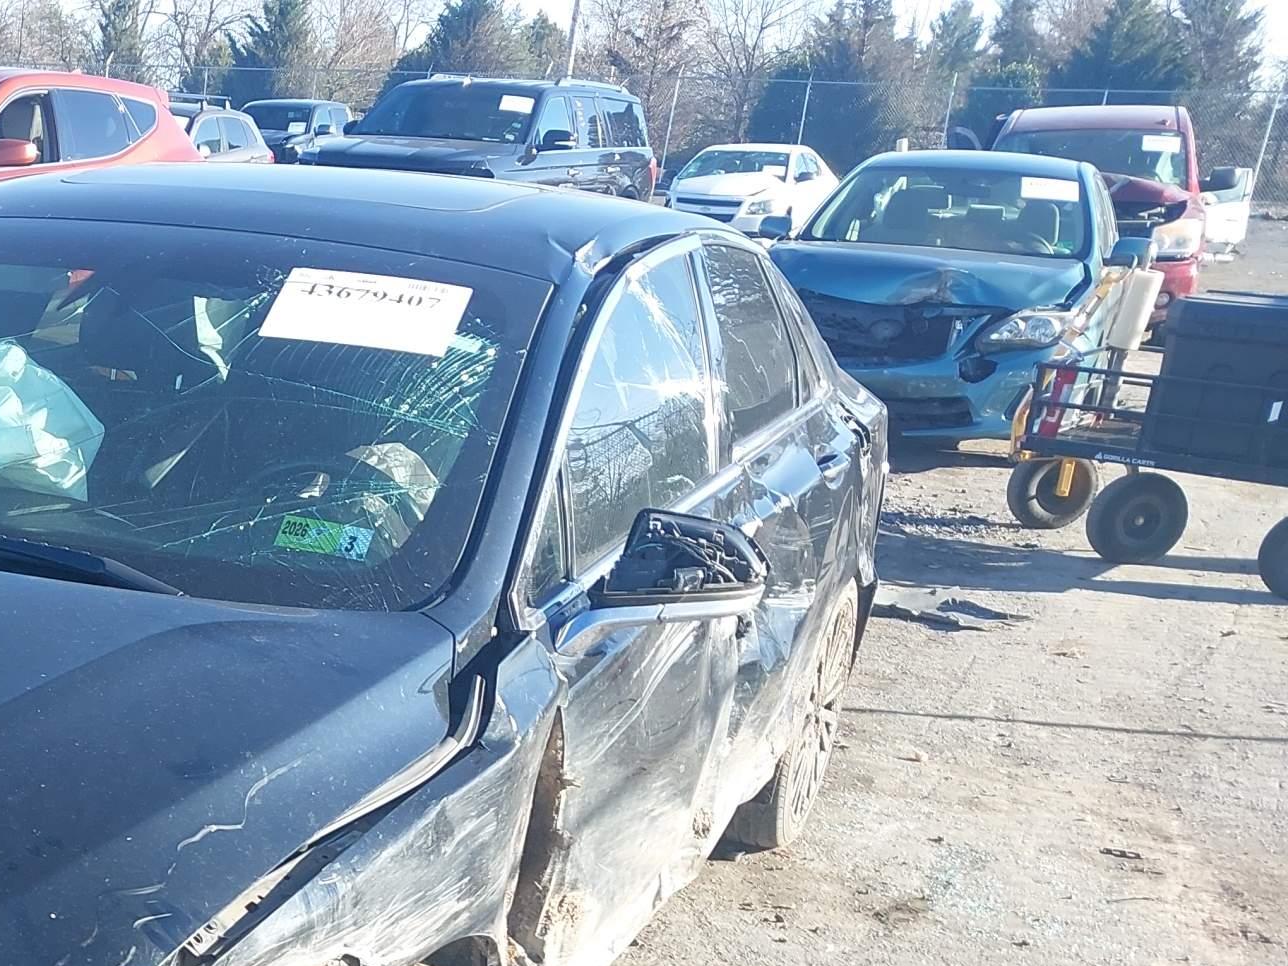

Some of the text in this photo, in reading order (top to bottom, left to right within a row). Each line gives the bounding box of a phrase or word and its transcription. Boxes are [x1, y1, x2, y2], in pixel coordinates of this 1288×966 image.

[300, 283, 441, 309] 43679407
[281, 520, 310, 538] 2026
[344, 535, 358, 552] 3
